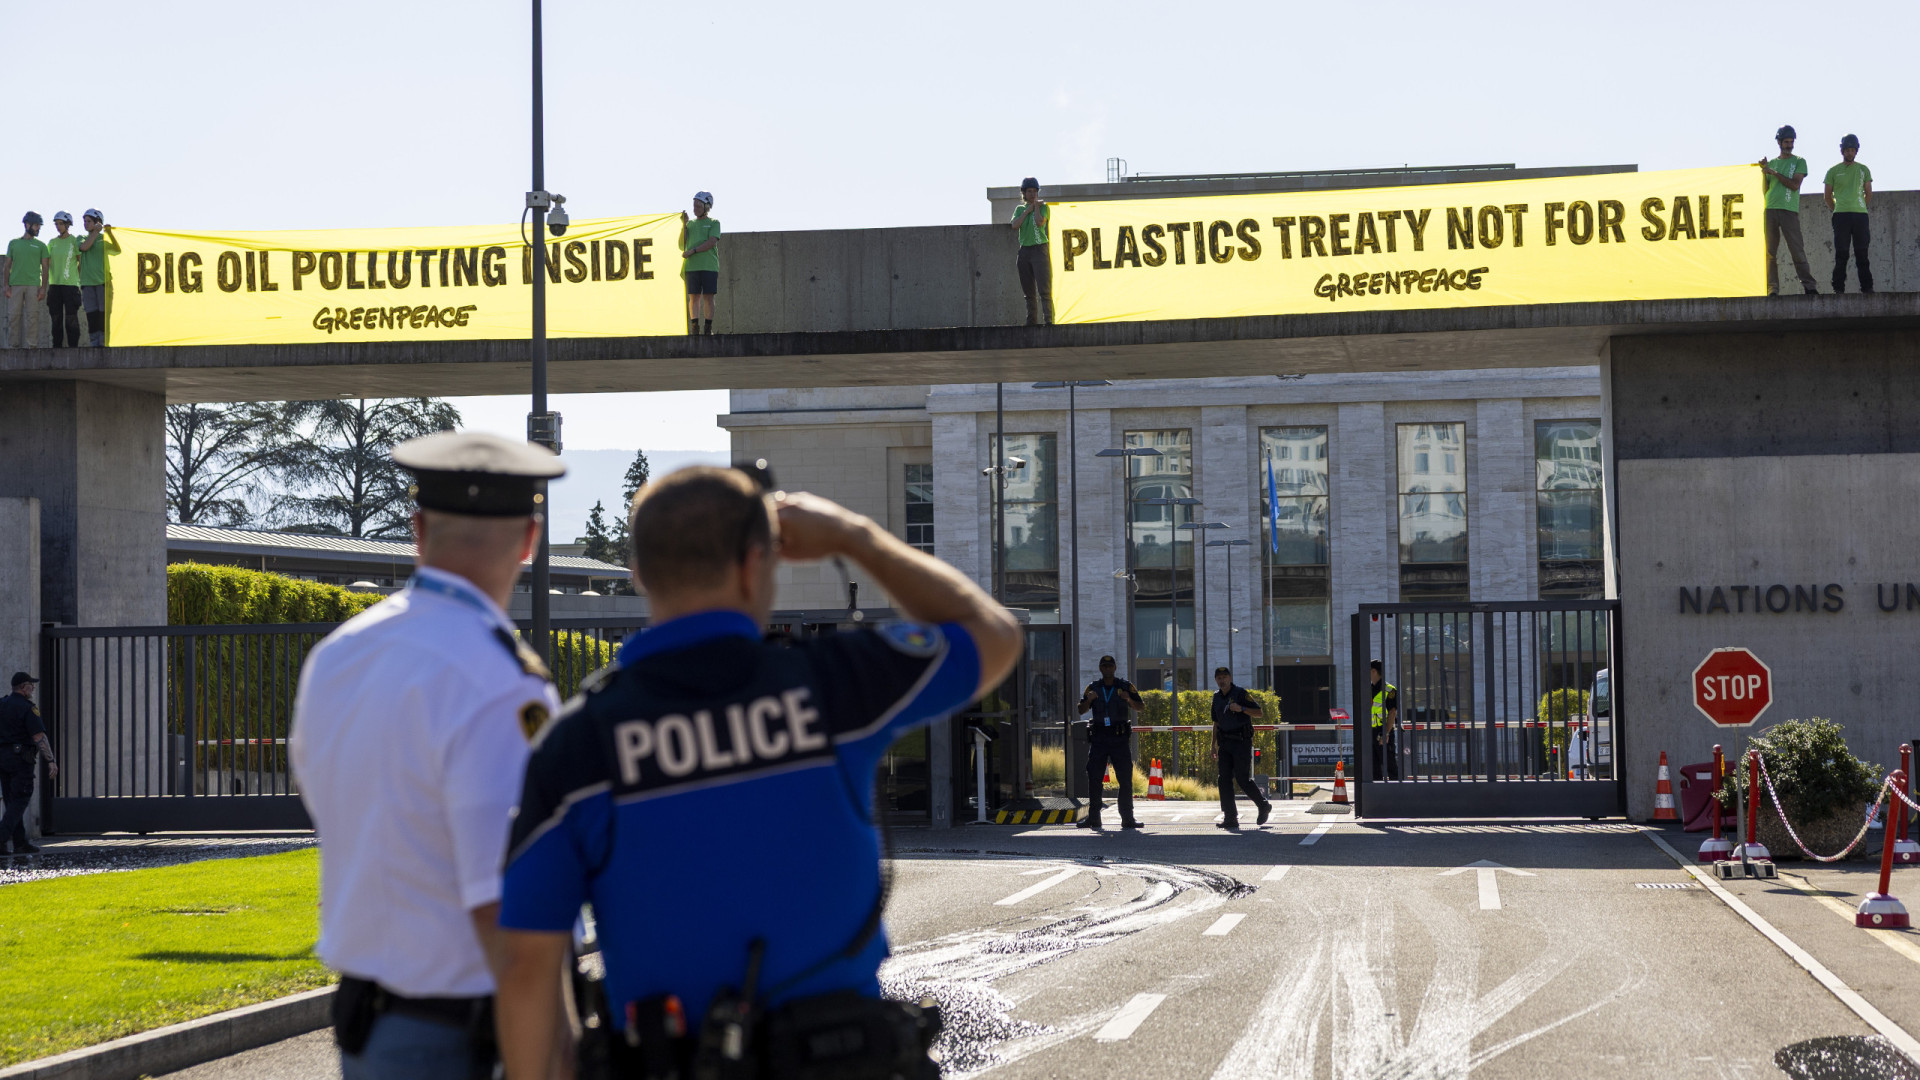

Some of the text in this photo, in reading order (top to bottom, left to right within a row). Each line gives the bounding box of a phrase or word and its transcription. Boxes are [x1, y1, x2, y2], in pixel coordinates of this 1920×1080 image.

[1063, 218, 1262, 272] PLASTICS
[1272, 208, 1433, 260] TREATY
[1446, 203, 1529, 250] NOT
[1544, 199, 1626, 247] FOR
[1641, 193, 1745, 242] SALE
[137, 239, 655, 294] BIG OIL POLLUTING INSIDE
[1313, 266, 1490, 302] GREENPEACE
[312, 304, 478, 334] GREENPEACE
[1679, 583, 1845, 615] NATIONS
[1702, 674, 1762, 701] STOP
[614, 688, 828, 786] POLICE
